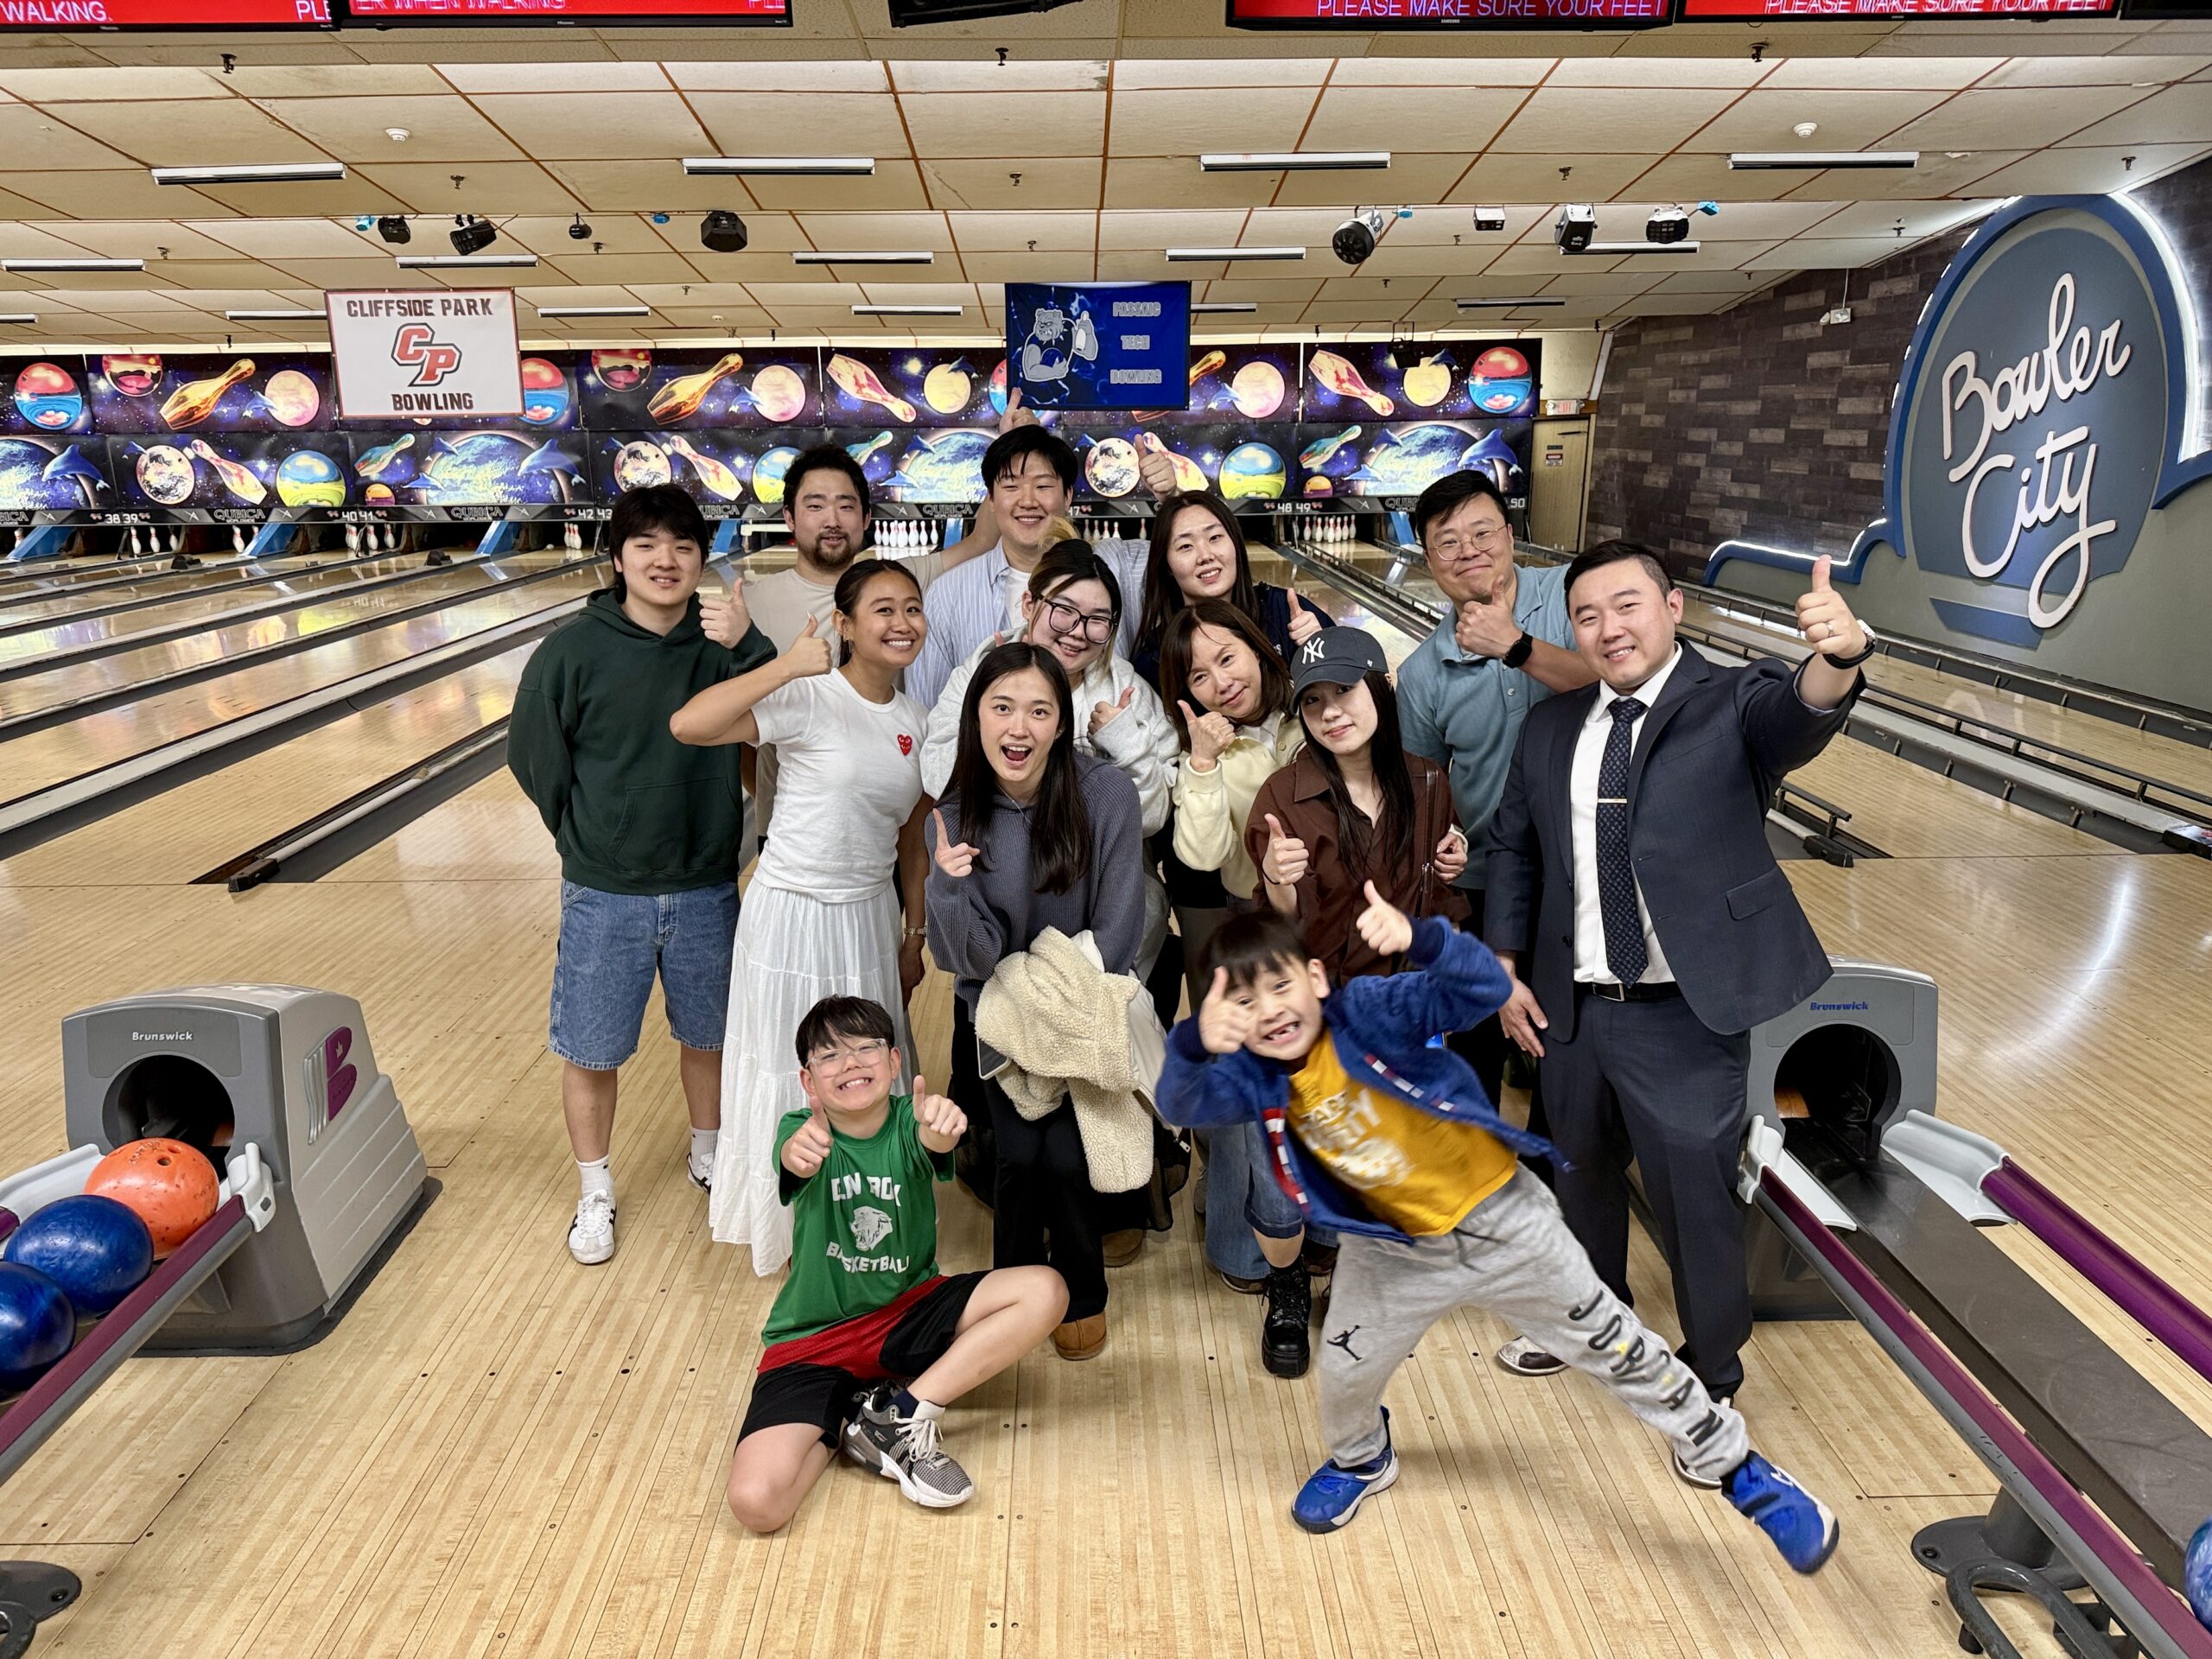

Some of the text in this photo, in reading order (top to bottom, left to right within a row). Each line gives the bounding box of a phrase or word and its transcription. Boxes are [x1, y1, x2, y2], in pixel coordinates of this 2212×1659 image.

[1317, 0, 1662, 16] PLEASE MAKE SURE YOUR FEET
[346, 298, 493, 317] CLIFFSIDE PARK
[1113, 302, 1161, 317] PASSAIC
[1121, 335, 1150, 350] TECH
[1110, 369, 1162, 384] BOWLING
[1942, 272, 2132, 482] Bowler
[391, 393, 474, 410] BOWLING
[578, 508, 613, 519] 42 43
[698, 505, 740, 515] UBICA
[1277, 503, 1311, 512] 48 49
[105, 513, 138, 524] 38 39
[341, 512, 373, 521] 40 41
[1961, 425, 2117, 629] City
[1301, 637, 1325, 664] NY
[1809, 1001, 1869, 1011] Brunswick
[132, 1032, 194, 1041] Brunswick
